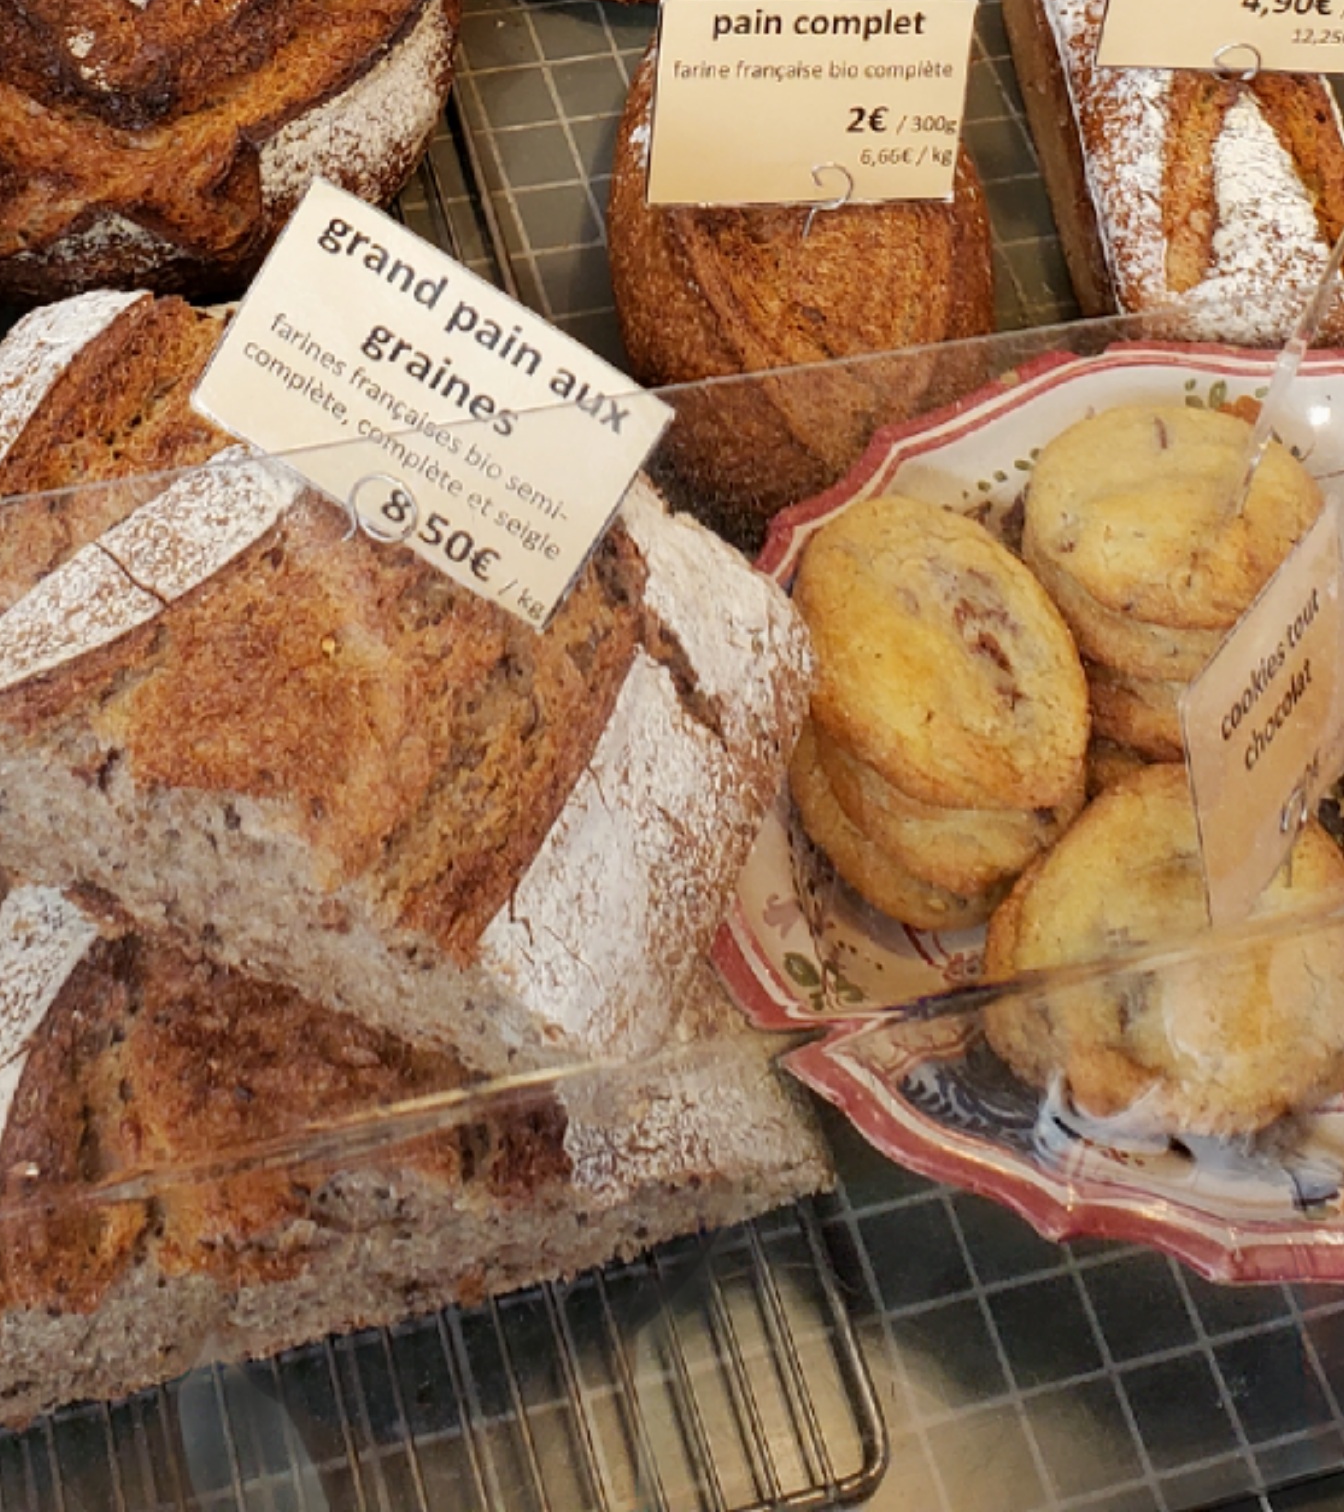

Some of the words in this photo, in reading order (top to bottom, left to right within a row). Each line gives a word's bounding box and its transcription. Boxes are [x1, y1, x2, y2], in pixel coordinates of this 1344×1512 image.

[674, 61, 730, 80] farine
[736, 60, 823, 82] française
[828, 61, 859, 78] bio
[864, 60, 953, 82] complète
[713, 9, 782, 40] pain
[794, 8, 926, 40] complet
[846, 106, 889, 133] 2€
[912, 115, 957, 134] 300g
[932, 146, 953, 166] kg
[317, 216, 448, 312] grand
[445, 298, 543, 376] pain
[549, 365, 631, 435] aux
[360, 324, 520, 438] graines
[243, 342, 349, 426] complète,
[357, 416, 464, 497] complète
[468, 492, 493, 511] et
[494, 508, 560, 560] seigle
[270, 312, 346, 376] farines
[348, 370, 460, 455] françaises
[464, 443, 503, 481] bio
[505, 474, 568, 524] semi-
[380, 488, 502, 583] 8,50€
[516, 588, 546, 621] kg
[1221, 640, 1285, 741] cookies
[1286, 588, 1320, 650] tout
[1244, 658, 1313, 772] chocolat
